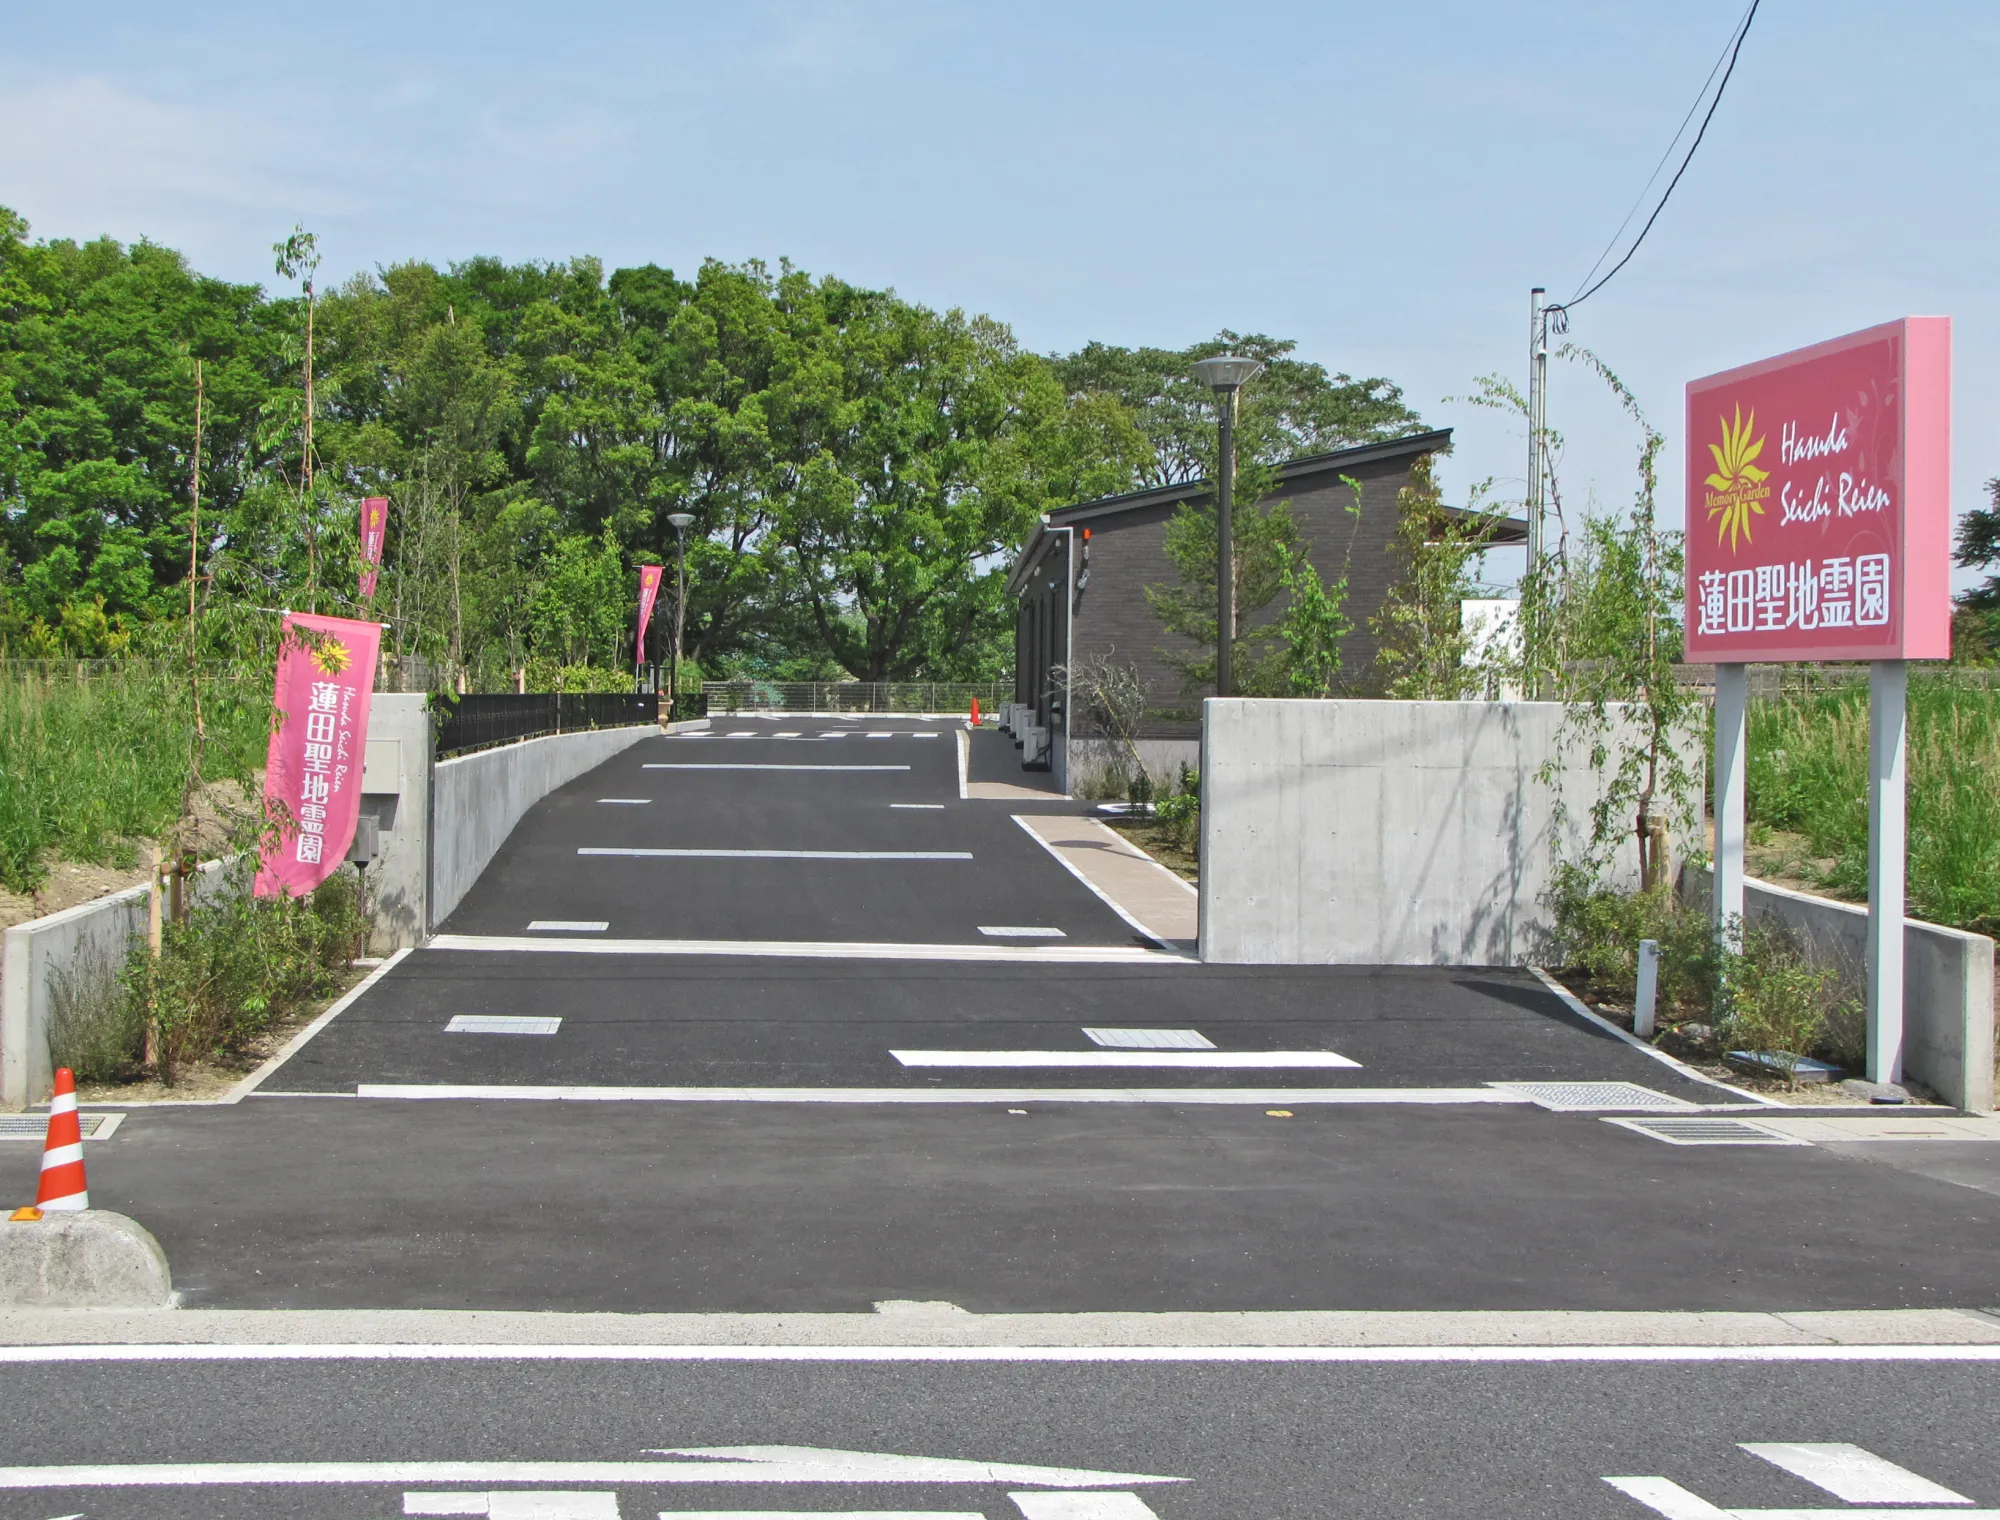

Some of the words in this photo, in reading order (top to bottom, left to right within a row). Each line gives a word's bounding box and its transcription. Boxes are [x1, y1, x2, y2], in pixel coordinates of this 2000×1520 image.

[1781, 412, 1849, 466] Hasuda
[1704, 491, 1737, 508] Memory
[1739, 482, 1770, 501] Garden
[1780, 476, 1831, 527] Seichi
[1838, 472, 1891, 518] Reien
[1698, 553, 1889, 635] 蓮田聖地霊園
[296, 681, 340, 865] 蓮田聖地霊園
